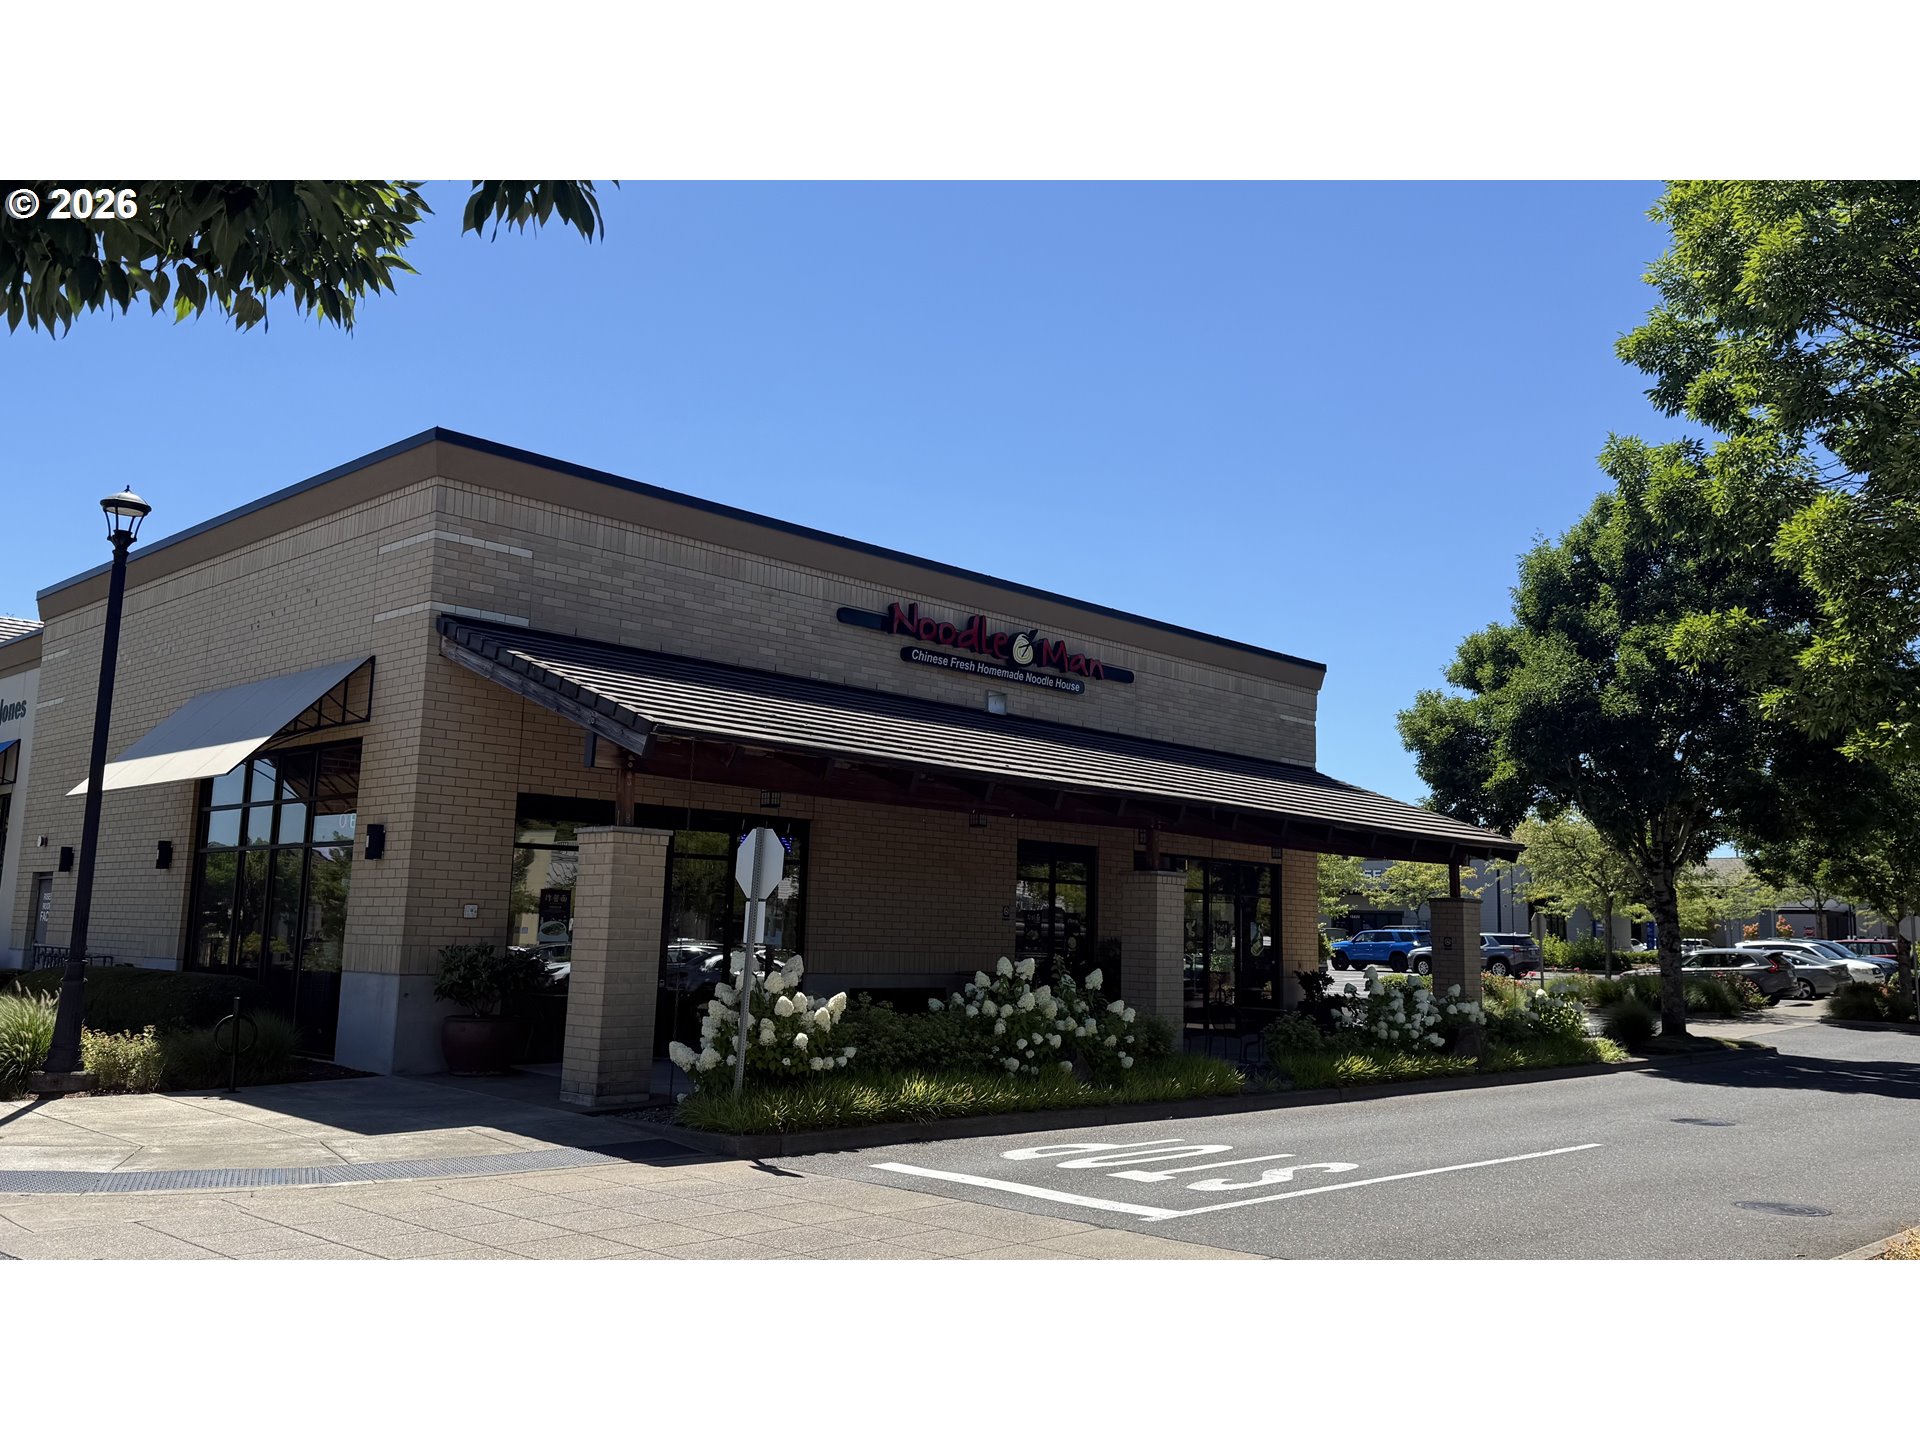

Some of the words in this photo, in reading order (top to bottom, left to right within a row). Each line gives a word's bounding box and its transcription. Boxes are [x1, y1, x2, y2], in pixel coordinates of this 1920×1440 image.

[888, 602, 1009, 660] Noodle
[1041, 638, 1105, 680] Man
[911, 649, 949, 666] Chinese
[950, 657, 976, 671] Fresh
[976, 662, 1024, 681] Homemade
[1025, 672, 1054, 687] Noodle
[1055, 678, 1080, 692] House
[1002, 1138, 1359, 1191] STOP
